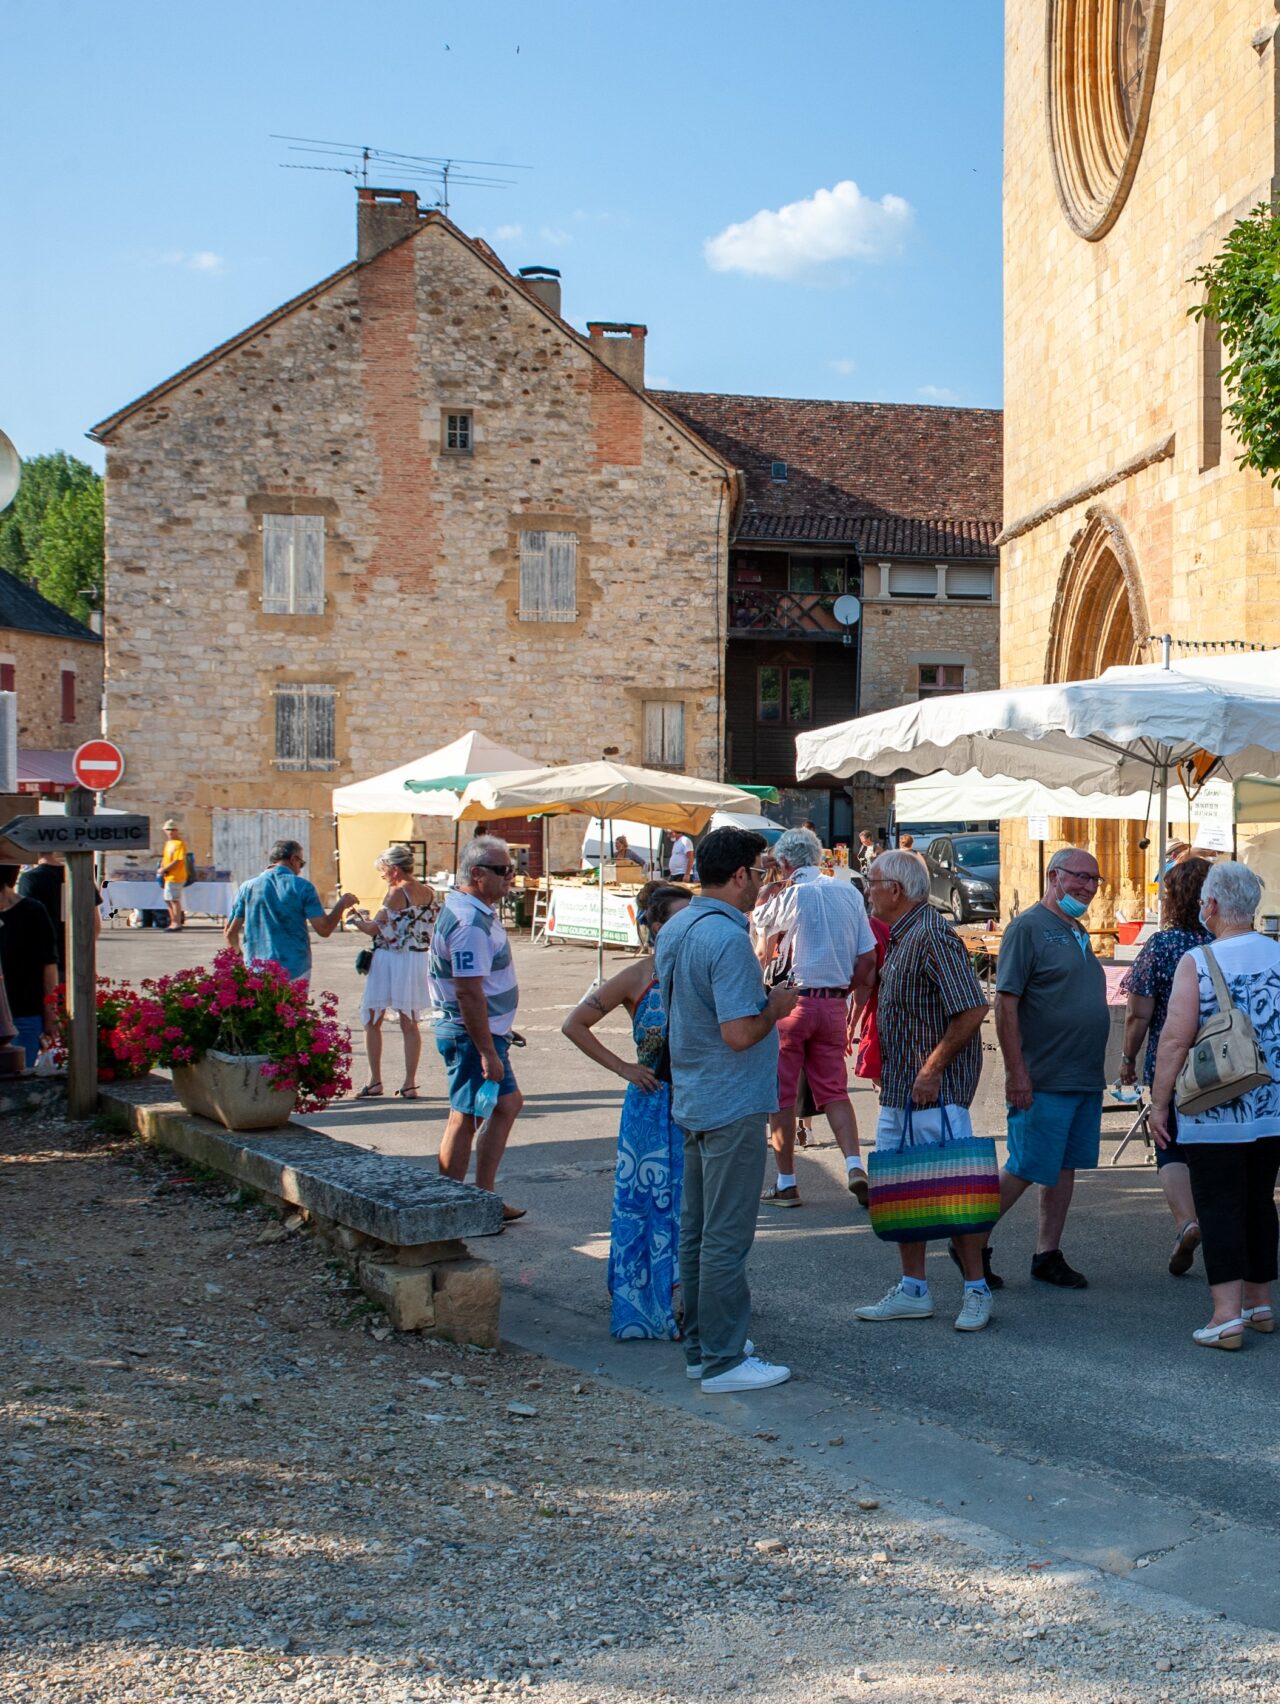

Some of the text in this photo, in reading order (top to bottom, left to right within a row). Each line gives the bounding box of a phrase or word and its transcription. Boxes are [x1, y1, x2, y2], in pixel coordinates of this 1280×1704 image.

[37, 826, 142, 841] WC PUBLIC
[454, 951, 475, 970] 12
